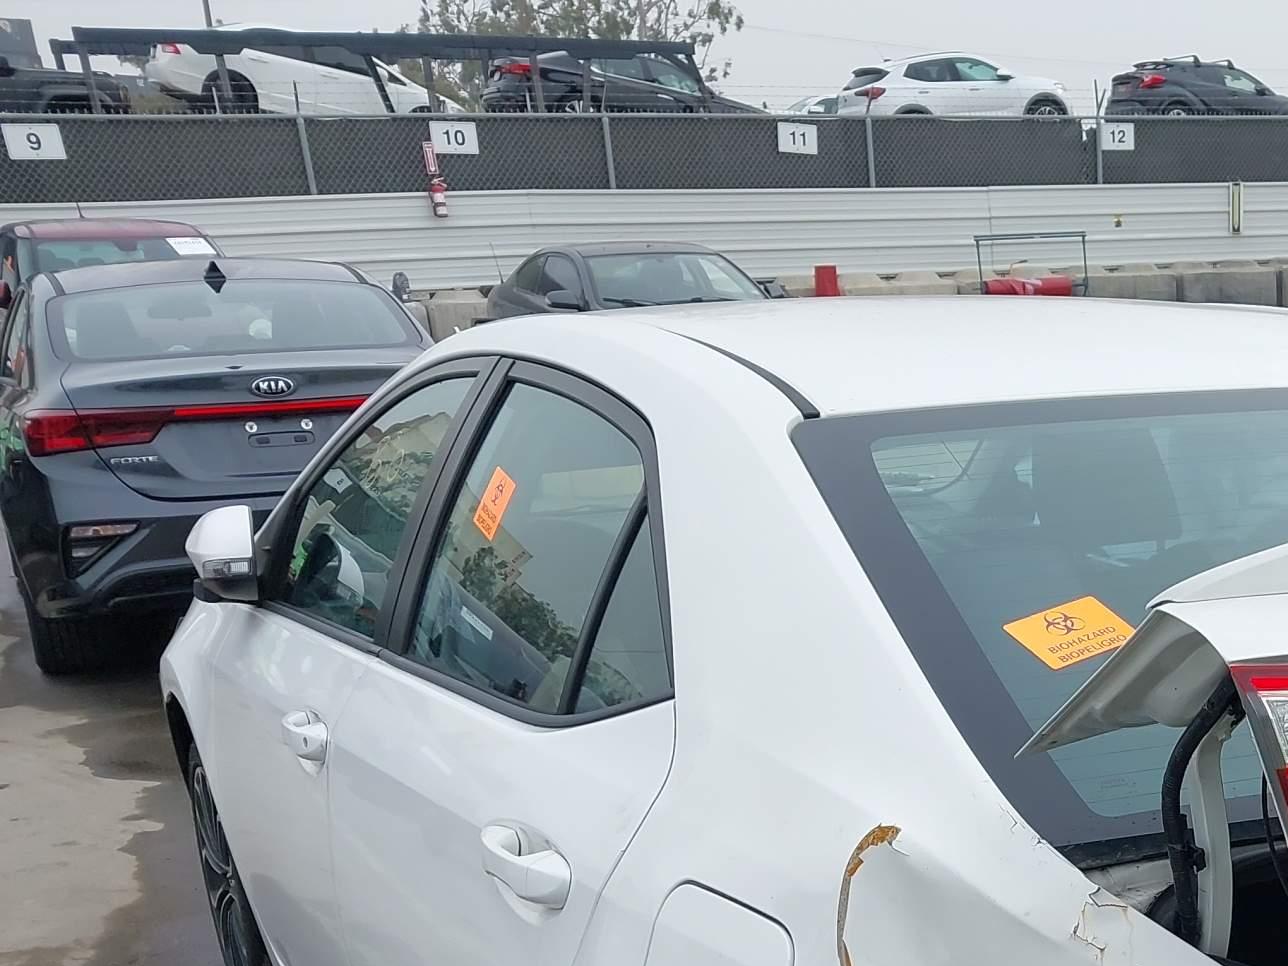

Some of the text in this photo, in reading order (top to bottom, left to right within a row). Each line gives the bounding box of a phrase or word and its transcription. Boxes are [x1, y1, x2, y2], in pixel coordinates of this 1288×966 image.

[26, 132, 42, 150] 9
[442, 129, 466, 146] 10
[789, 130, 806, 146] 11
[1110, 129, 1126, 143] 12
[258, 380, 288, 393] KIA
[110, 455, 159, 464] FORTE
[1047, 625, 1117, 655] BIOHAZARD
[1056, 634, 1128, 663] BIOPELIGRO
